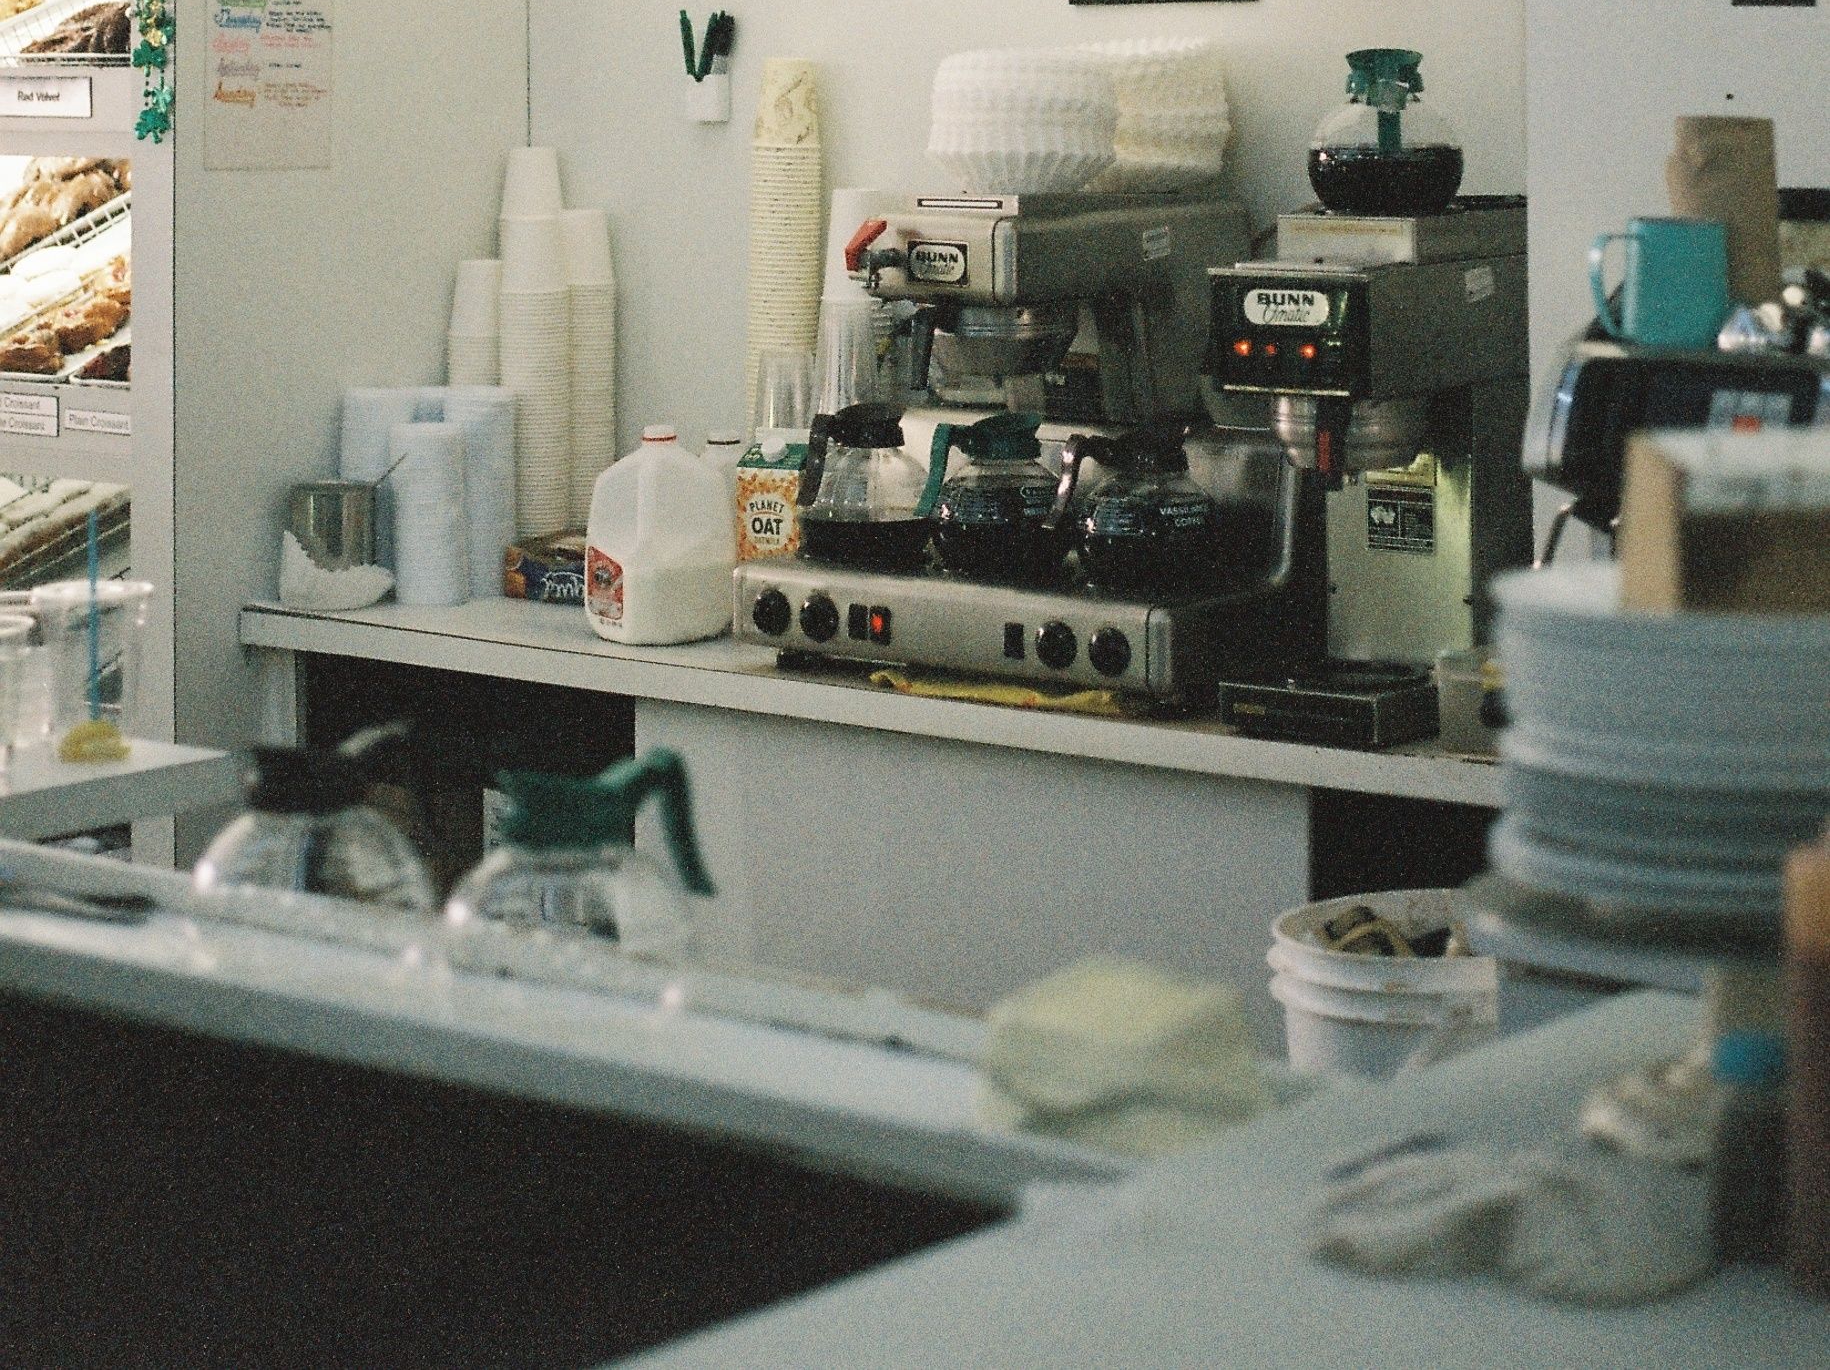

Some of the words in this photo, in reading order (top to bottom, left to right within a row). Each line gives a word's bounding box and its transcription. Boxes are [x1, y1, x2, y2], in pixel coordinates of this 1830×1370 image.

[1257, 292, 1315, 307] BUNN
[749, 499, 785, 514] PLANET
[752, 517, 784, 536] OAT
